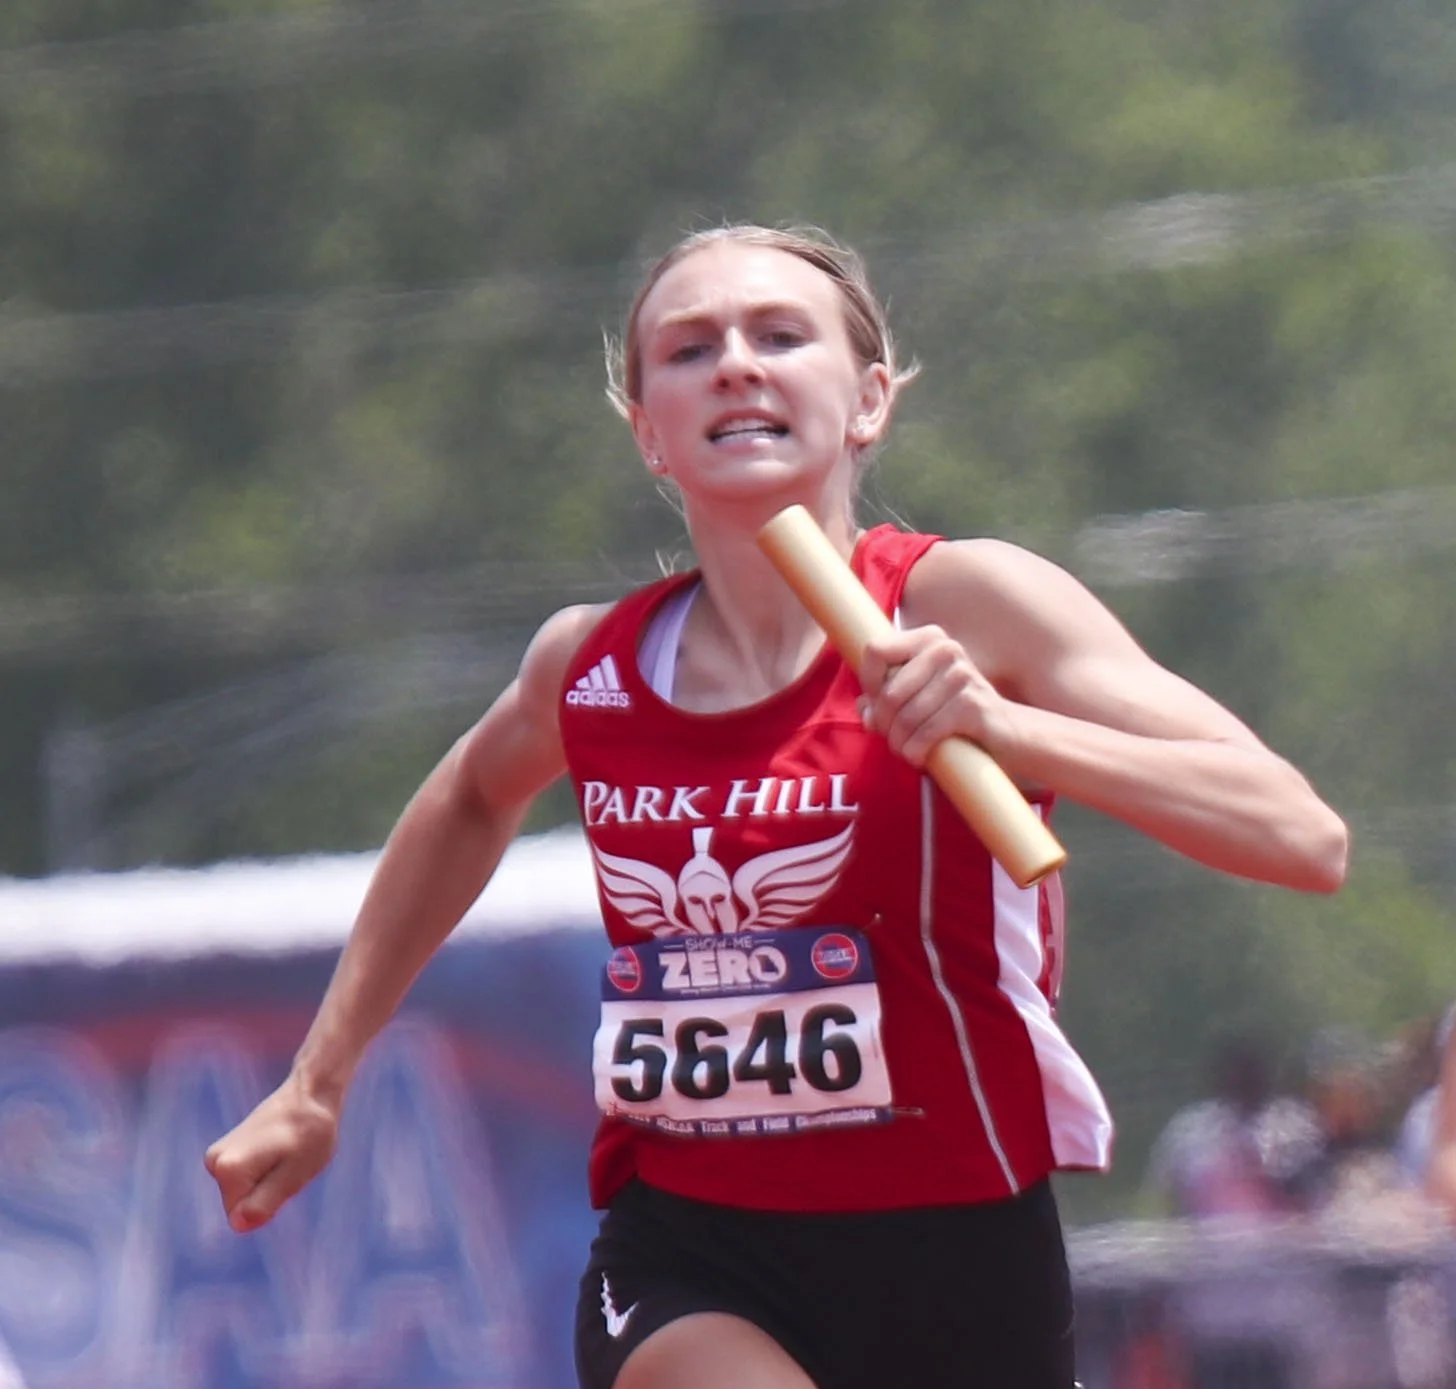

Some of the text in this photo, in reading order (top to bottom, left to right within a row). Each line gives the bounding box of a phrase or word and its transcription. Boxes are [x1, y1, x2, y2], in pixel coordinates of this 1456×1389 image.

[566, 690, 630, 708] adidas
[582, 774, 859, 827] PARK HILL
[658, 946, 786, 990] ZERO
[611, 1003, 862, 1102] 5646
